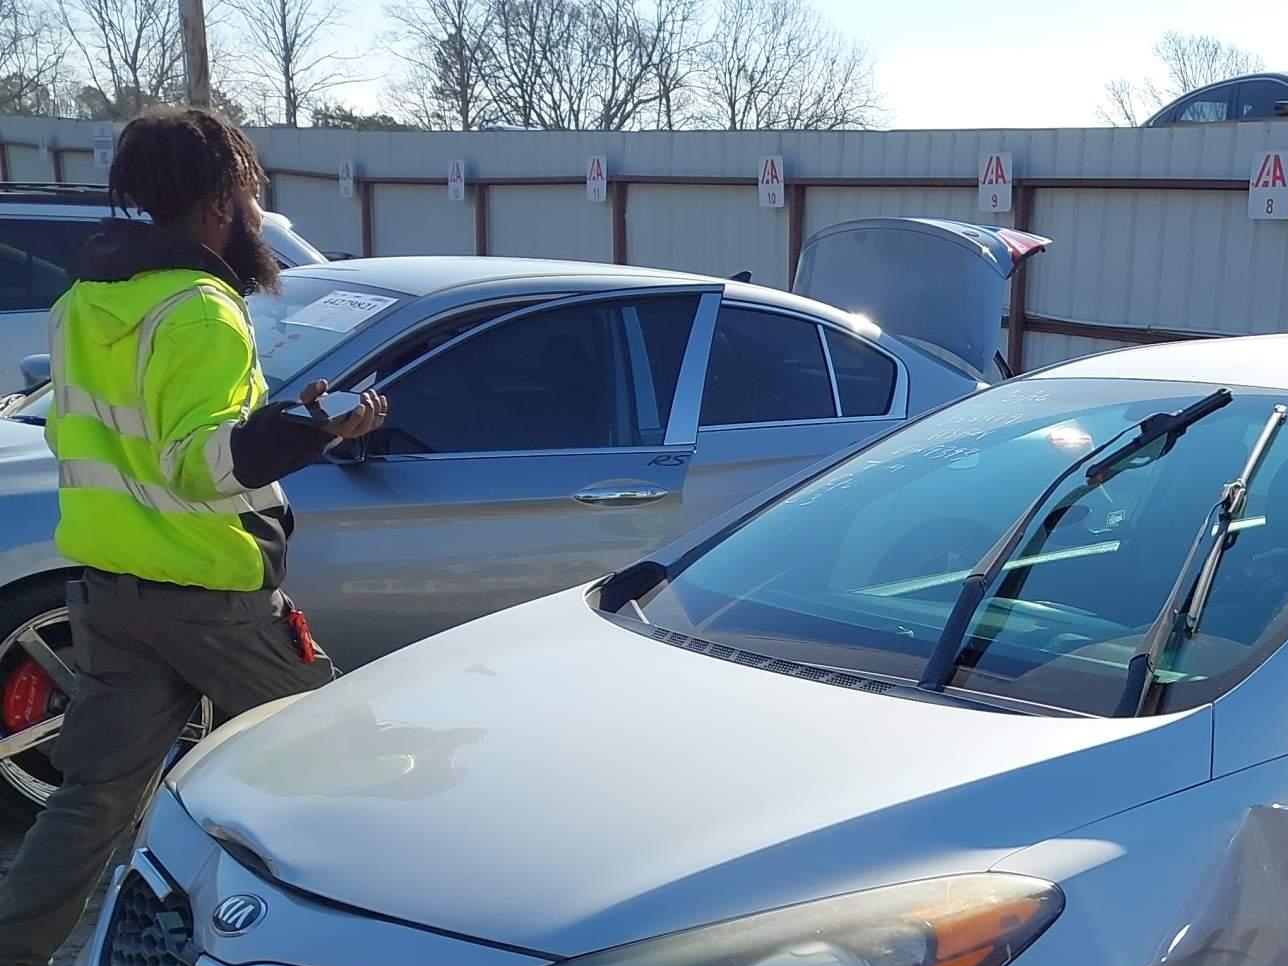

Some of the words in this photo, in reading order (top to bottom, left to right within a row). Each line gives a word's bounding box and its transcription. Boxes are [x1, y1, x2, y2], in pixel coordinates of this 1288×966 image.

[767, 192, 776, 205] 10
[991, 194, 998, 208] 9
[1266, 199, 1274, 214] 8
